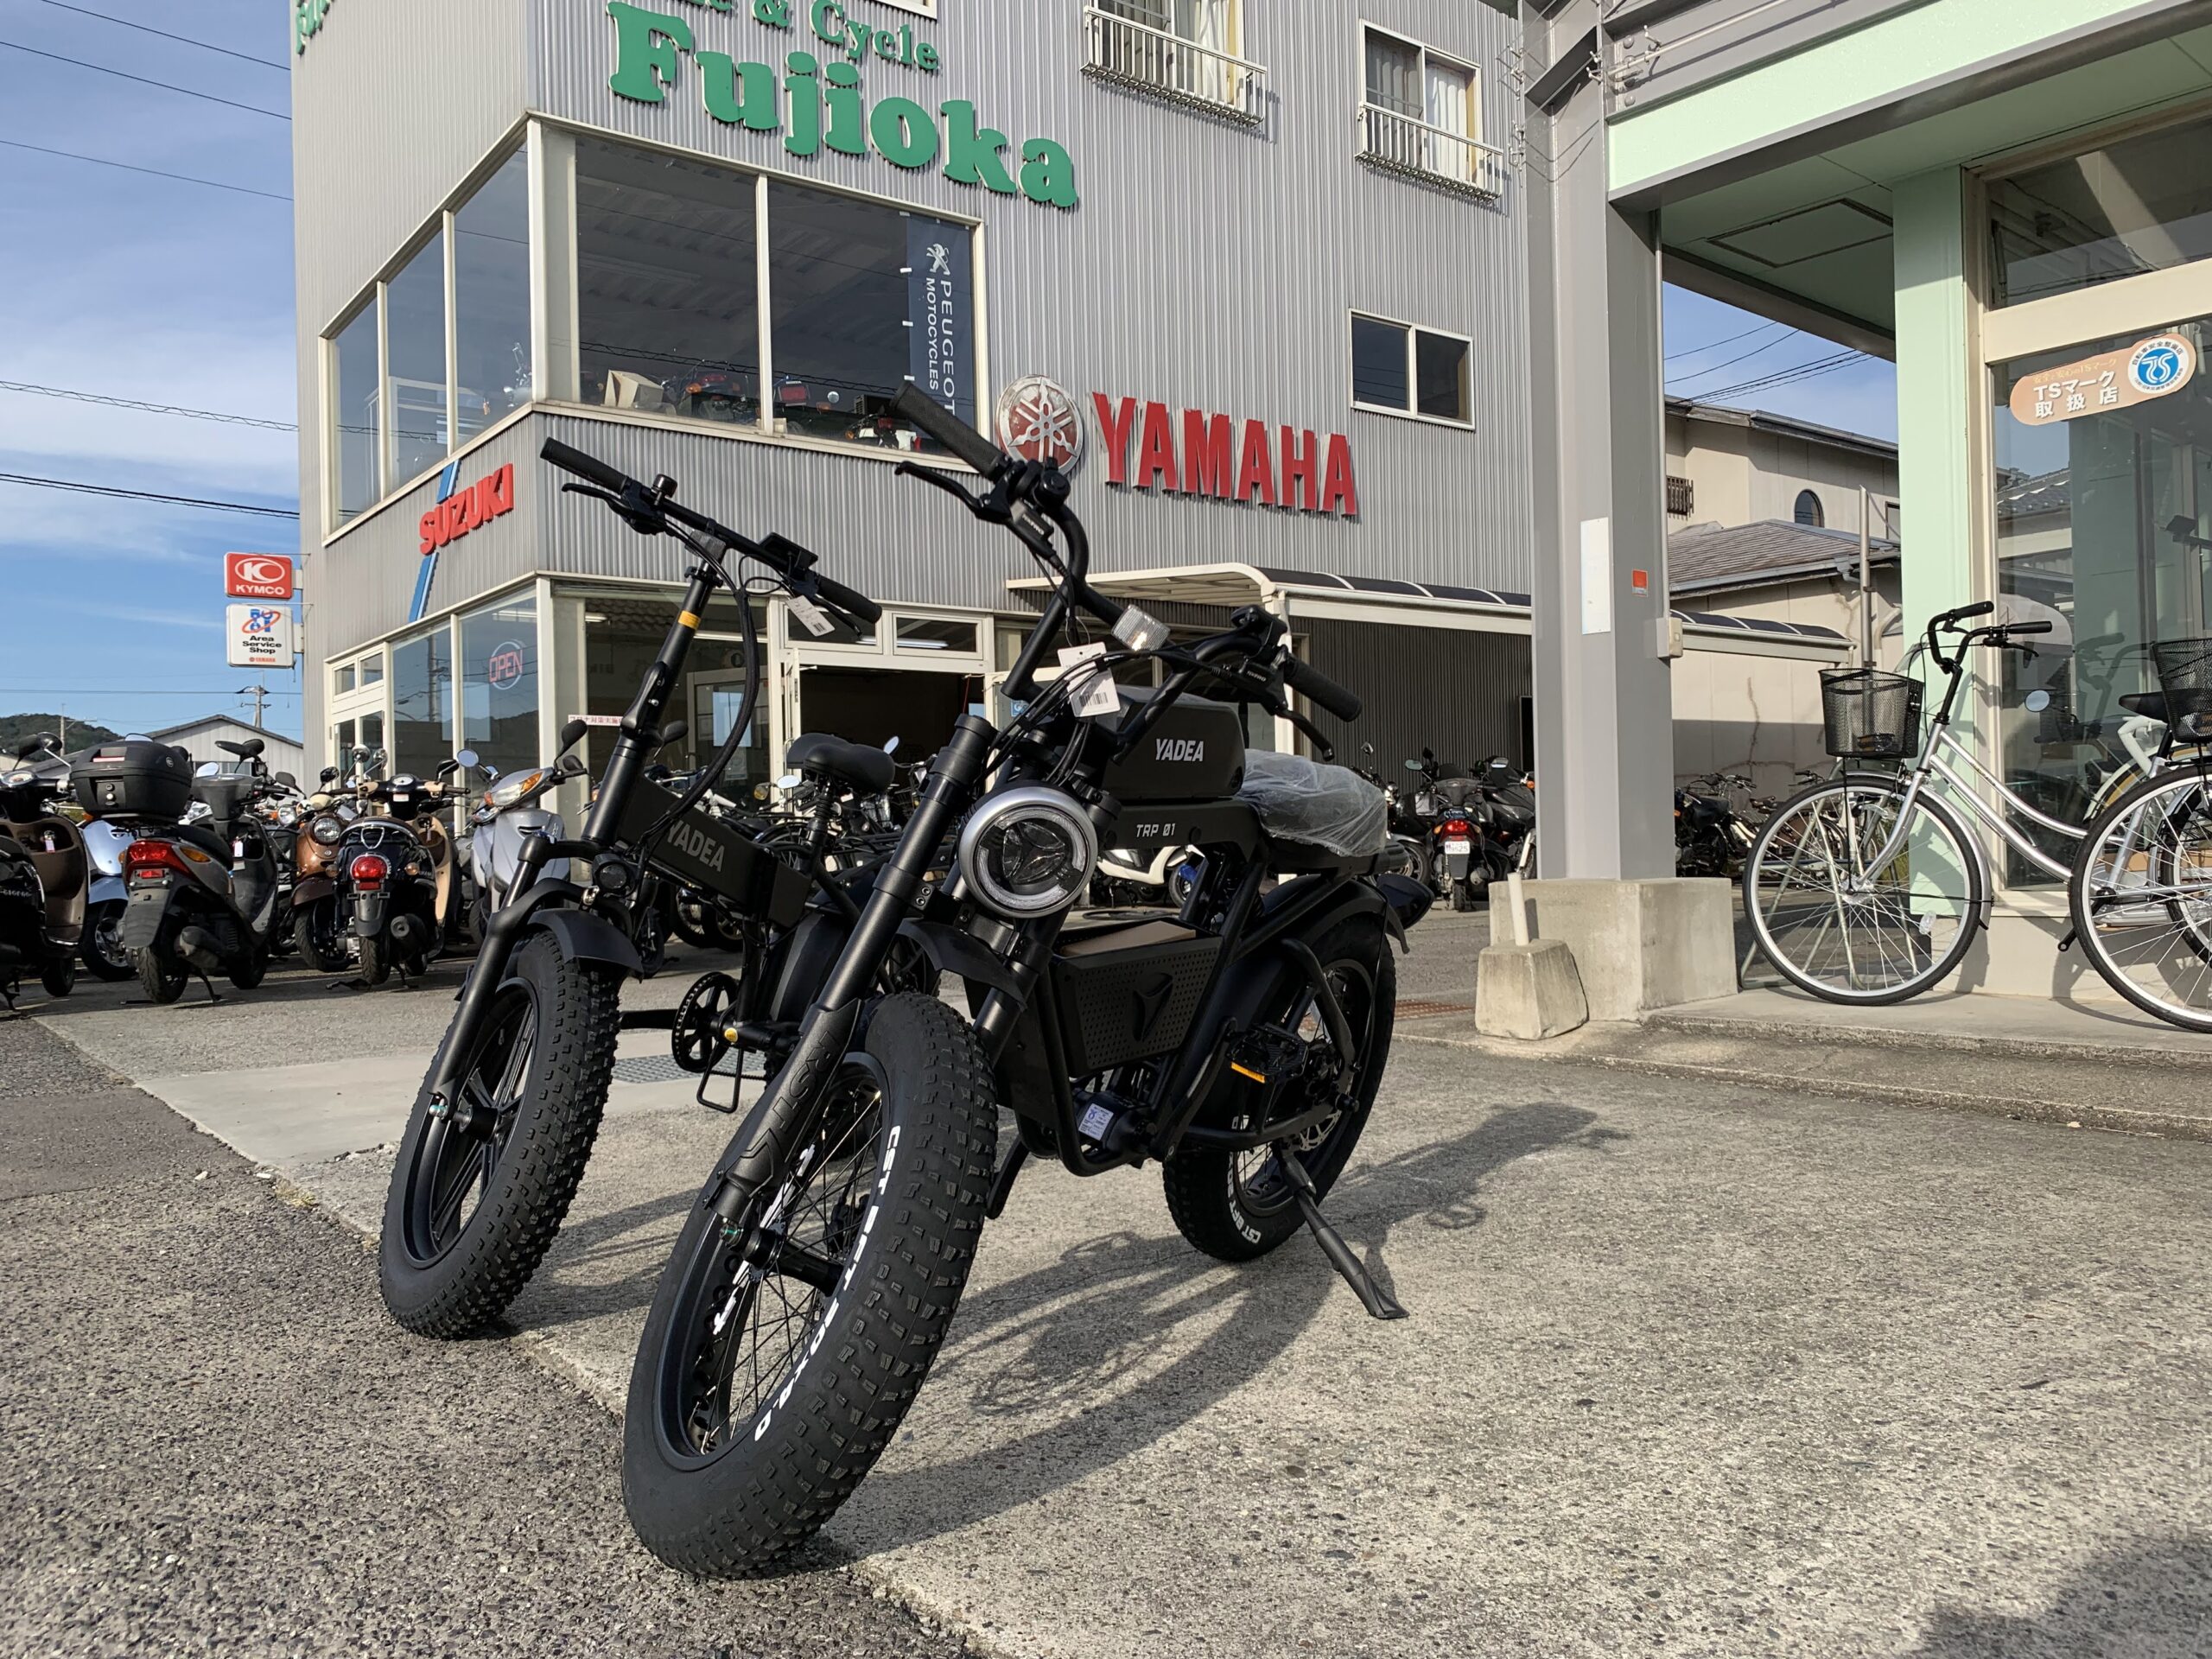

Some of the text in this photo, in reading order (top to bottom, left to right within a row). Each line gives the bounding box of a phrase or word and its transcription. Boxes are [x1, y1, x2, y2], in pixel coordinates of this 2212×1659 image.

[810, 0, 938, 71] Cycle
[606, 1, 1077, 208] Fujioka
[925, 277, 939, 391] MOTOCYCLES
[940, 280, 957, 416] PEUGEOT
[2033, 370, 2116, 402] TSマーク
[1089, 391, 1359, 518] YAMAHA
[419, 463, 514, 556] SUZUKI
[236, 584, 285, 595] KYMCO
[249, 646, 276, 655] Shop
[489, 650, 523, 683] OPEN
[1155, 738, 1205, 762] YADEA
[667, 819, 725, 873] YADEA
[1136, 823, 1160, 838] TRP
[878, 1125, 901, 1196] CST
[843, 1205, 880, 1291] BFT
[1241, 1224, 1262, 1244] CST
